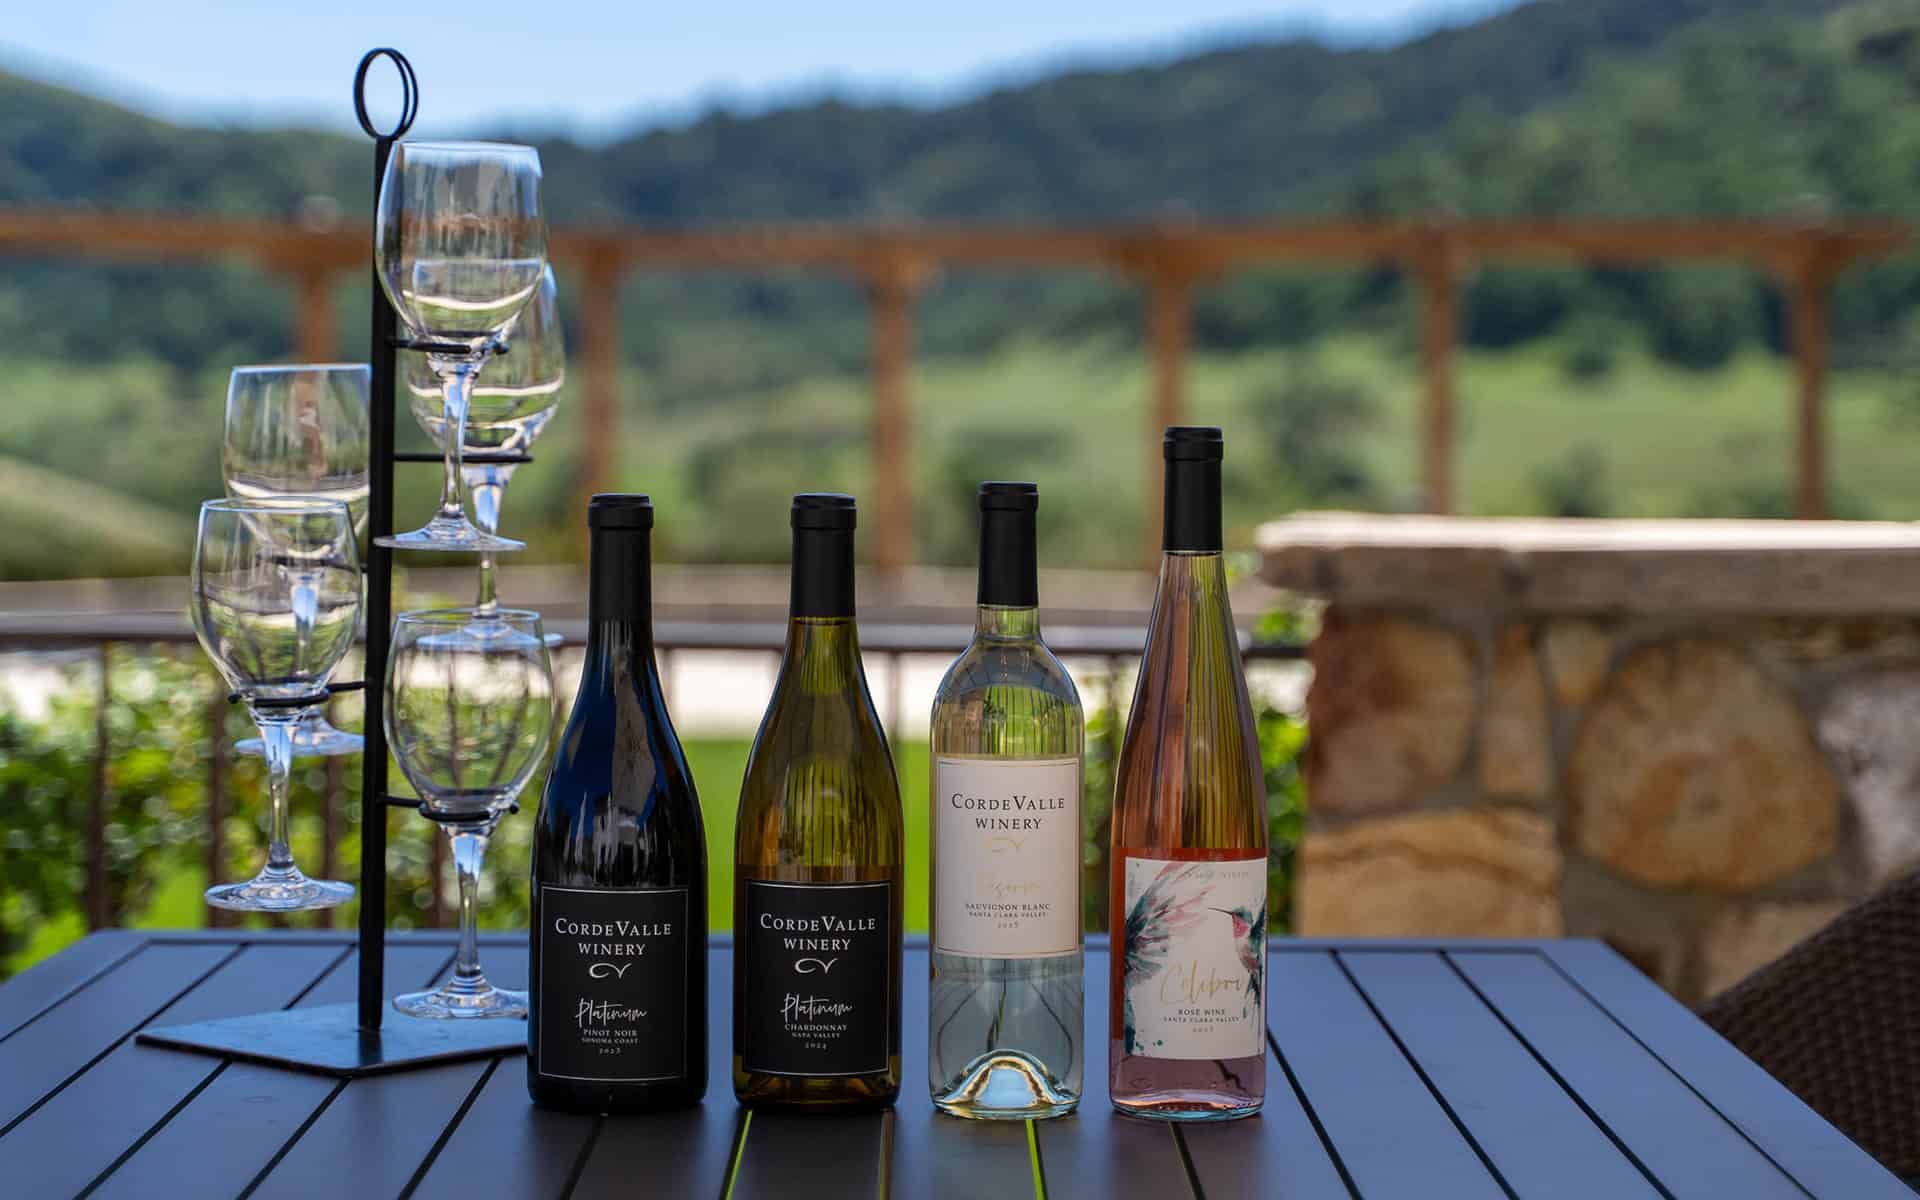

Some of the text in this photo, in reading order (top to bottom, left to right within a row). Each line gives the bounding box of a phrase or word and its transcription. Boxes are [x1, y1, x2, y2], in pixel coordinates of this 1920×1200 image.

[976, 818, 1043, 830] WINERY
[965, 903, 1051, 911] SAUVIGNON BLANC
[577, 942, 646, 956] WINERY
[784, 938, 851, 951] WINERY
[574, 997, 648, 1028] Platinum
[780, 992, 853, 1023] Platinum
[1204, 1008, 1226, 1016] WINE
[583, 1029, 638, 1037] PINOT NOIR
